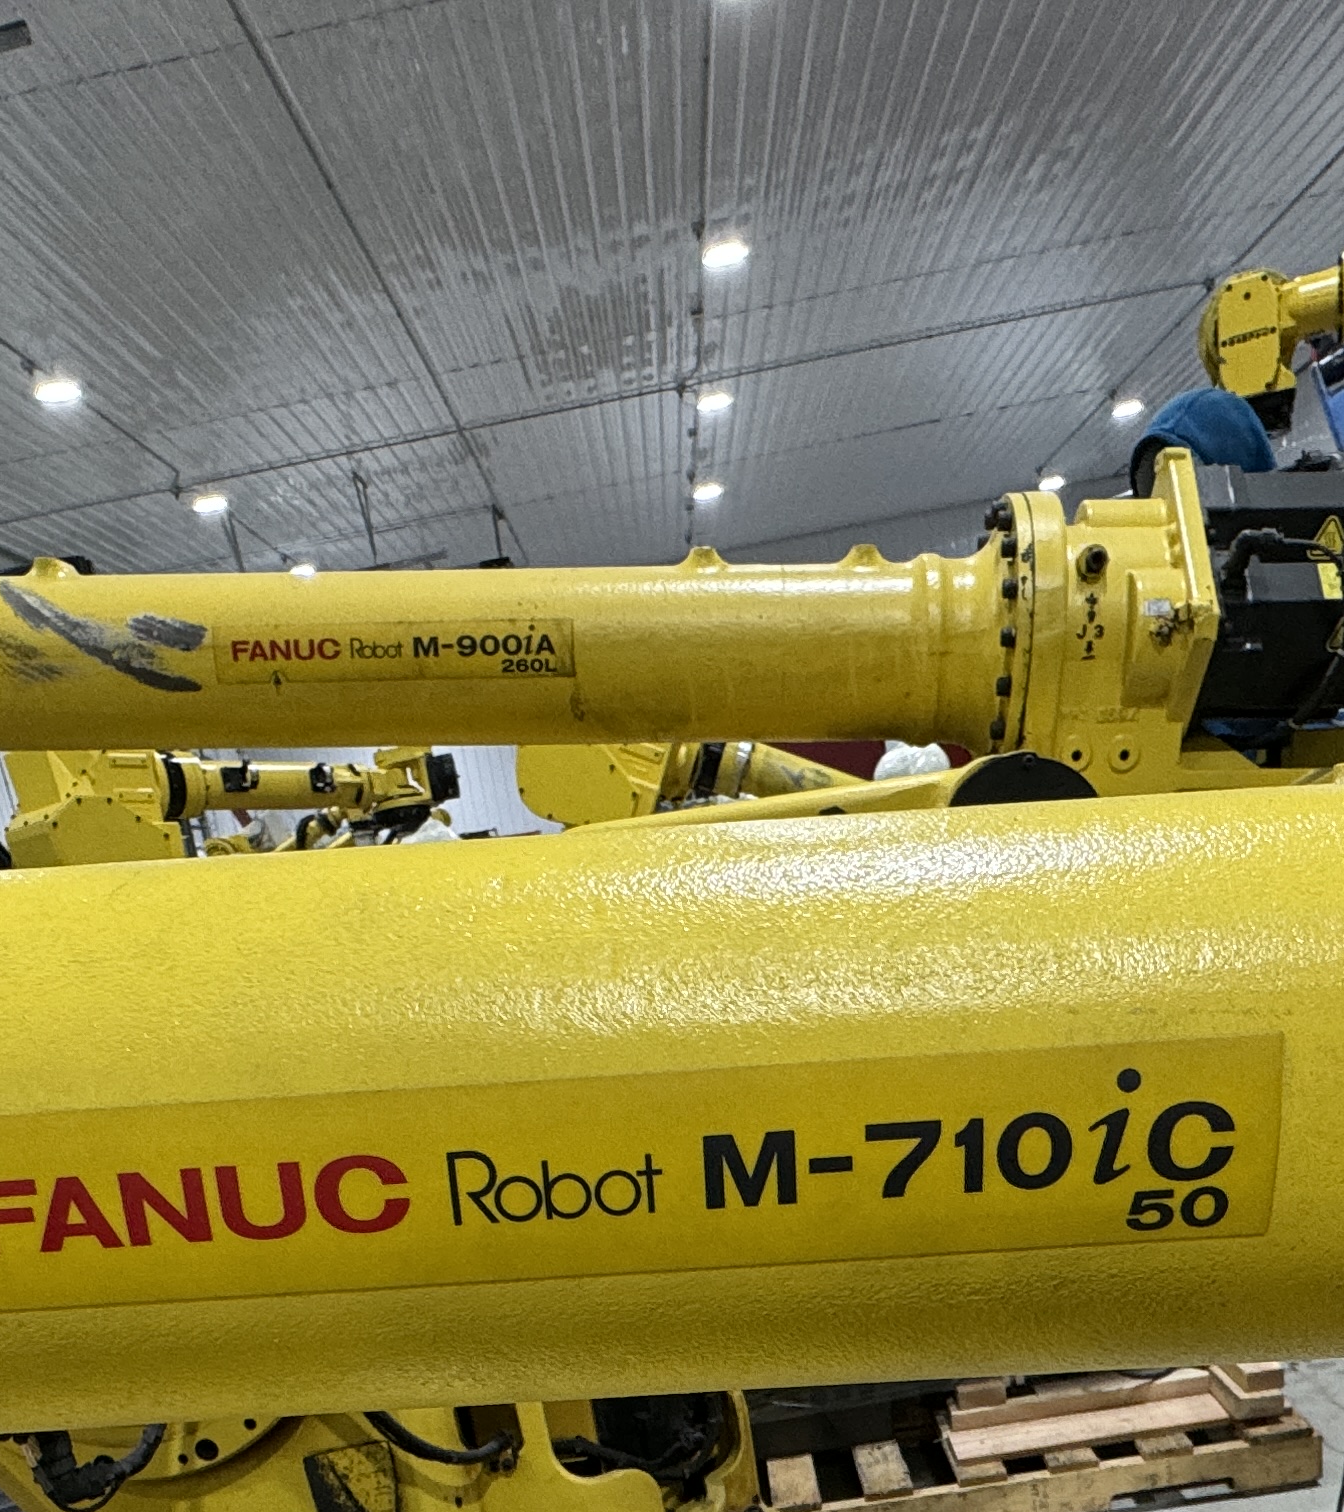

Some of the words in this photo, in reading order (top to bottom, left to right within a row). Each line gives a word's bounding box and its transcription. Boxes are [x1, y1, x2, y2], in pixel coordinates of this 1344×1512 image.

[231, 637, 341, 662] FANUC
[349, 637, 403, 660] Robot
[413, 623, 556, 658] M-900iA
[501, 658, 557, 674] 260L
[446, 1150, 663, 1226] Robot
[702, 1067, 1236, 1211] M-710iC
[1125, 1186, 1230, 1232] 50
